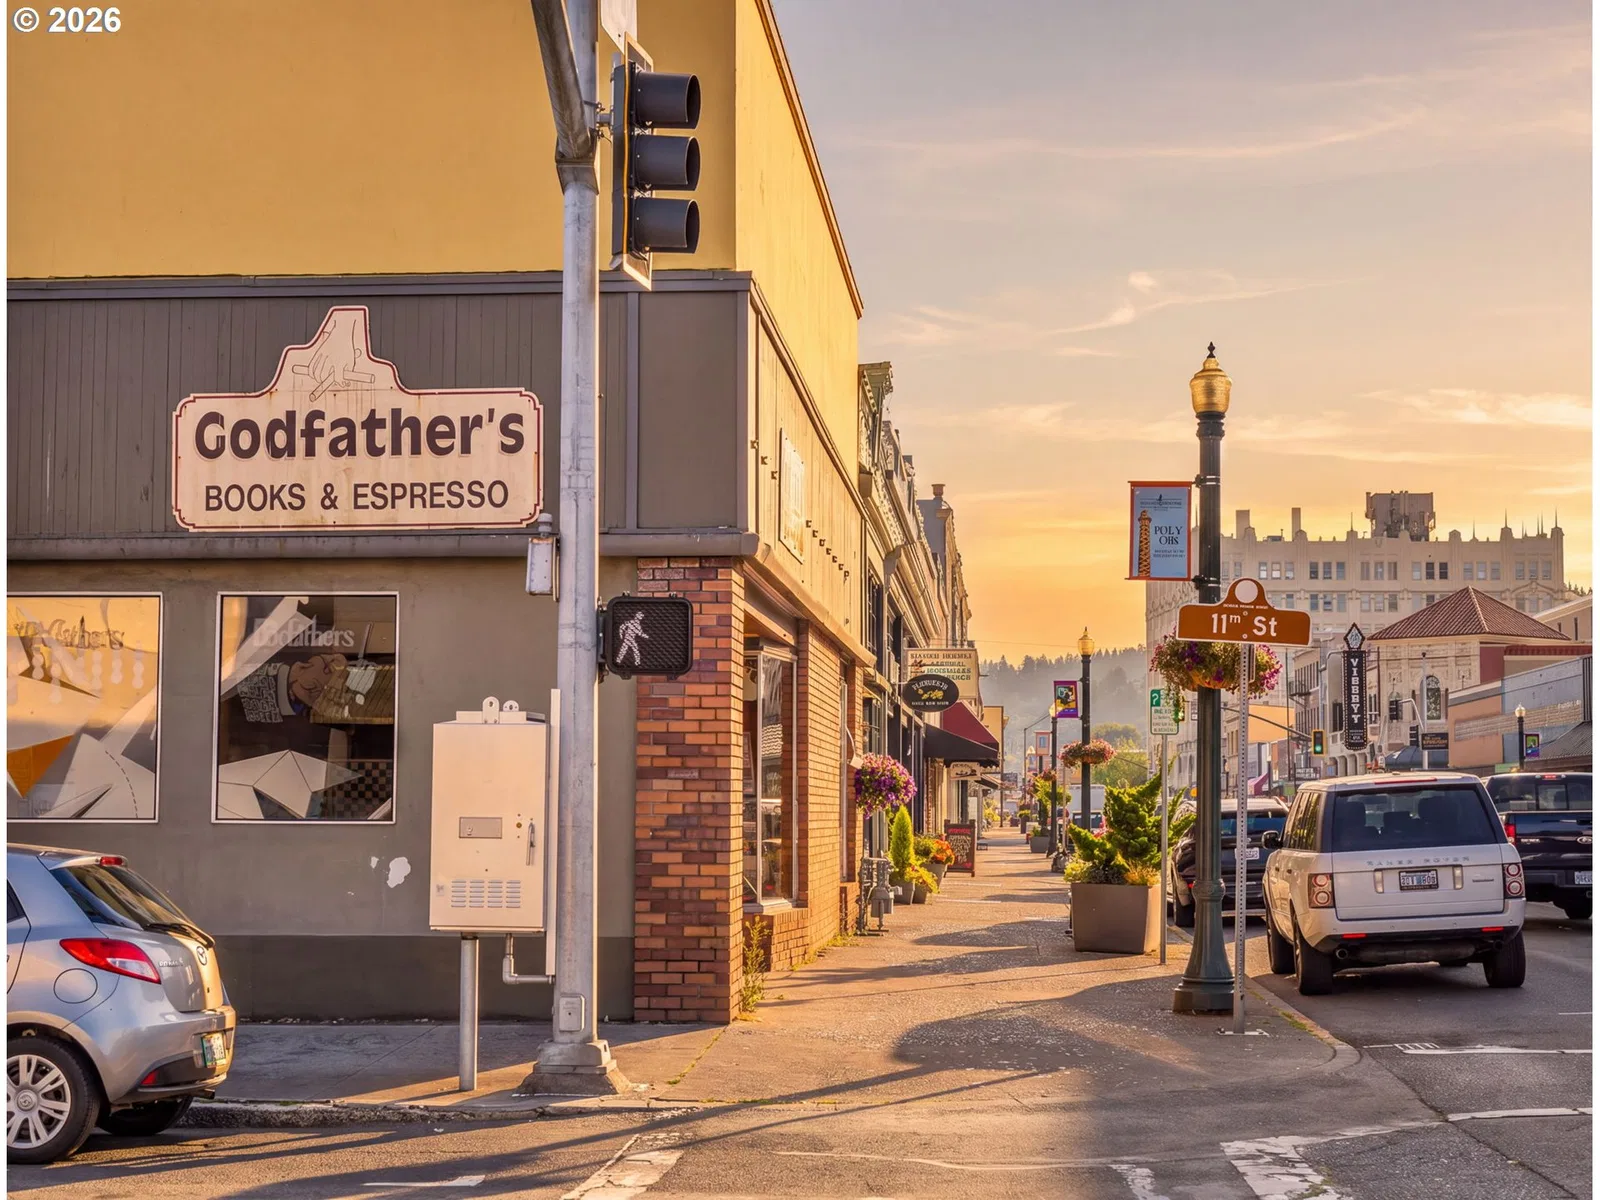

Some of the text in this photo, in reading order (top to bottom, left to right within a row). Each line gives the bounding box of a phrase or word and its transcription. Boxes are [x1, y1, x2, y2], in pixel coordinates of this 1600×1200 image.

[194, 408, 525, 460] Godfather's
[205, 480, 509, 511] BOOKS & ESPRESSO
[1252, 615, 1278, 637] St
